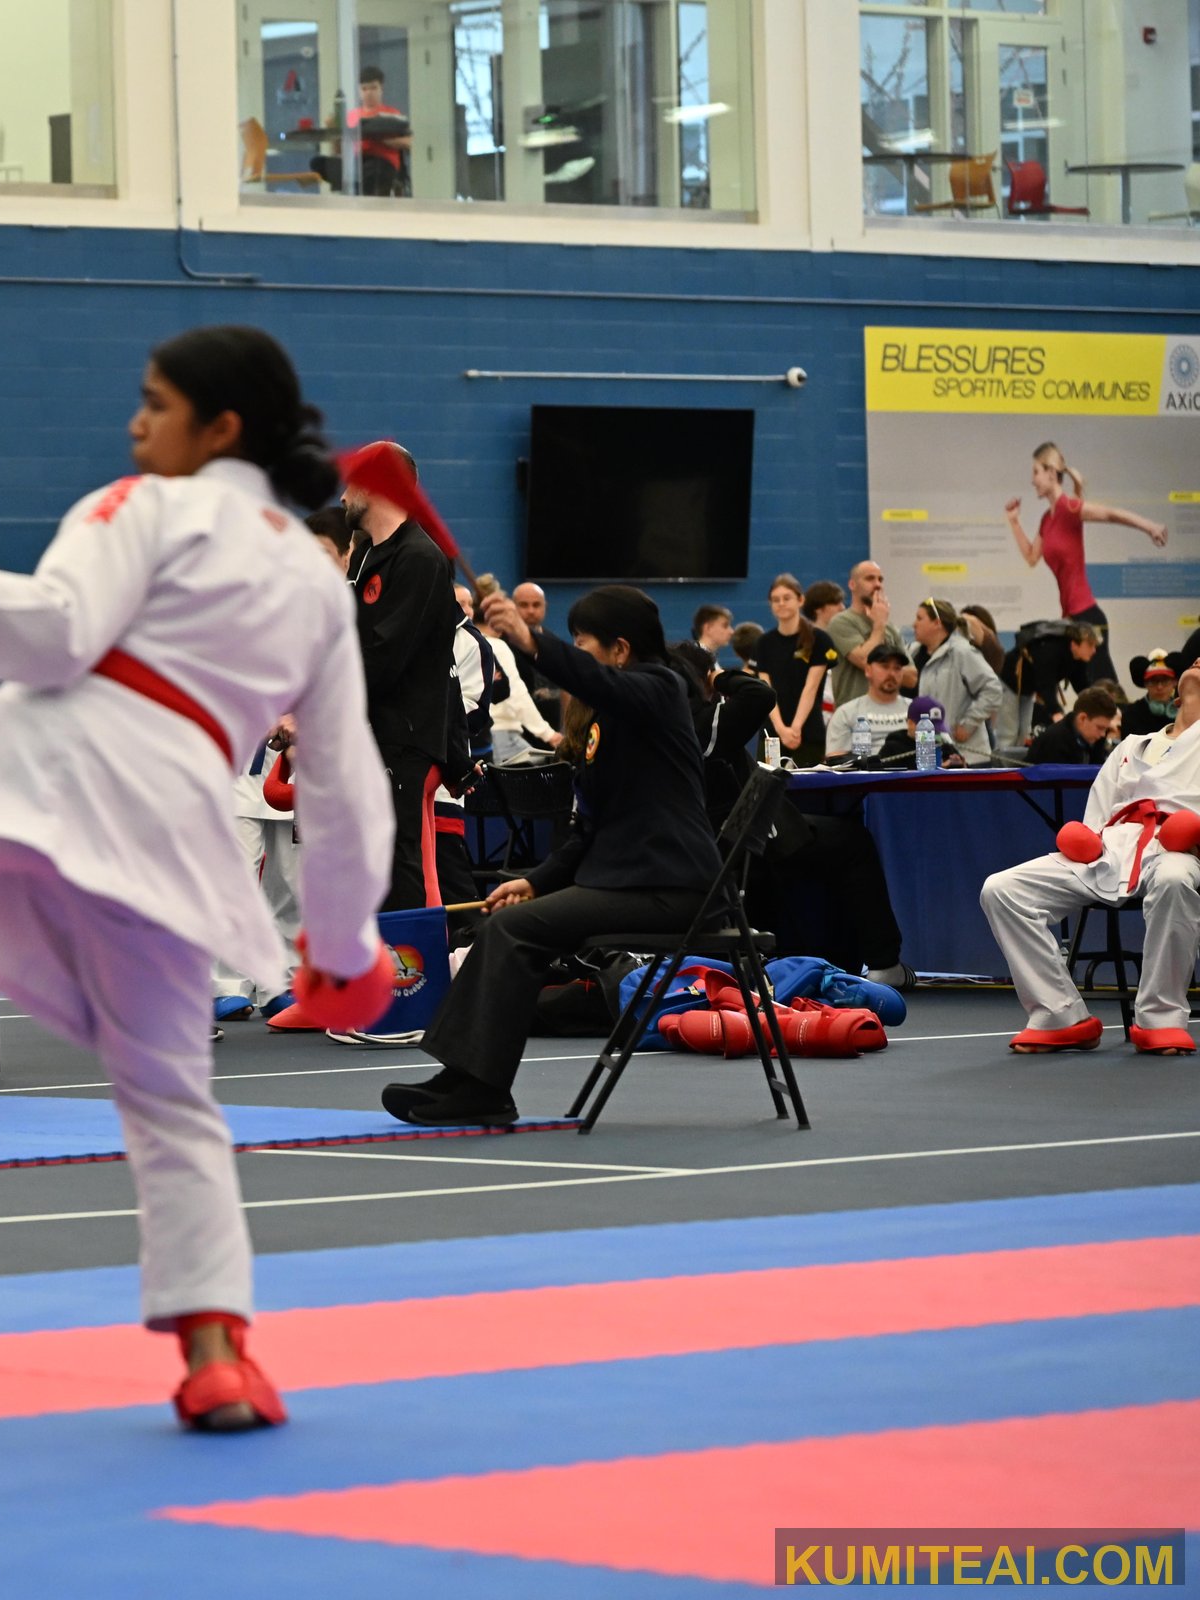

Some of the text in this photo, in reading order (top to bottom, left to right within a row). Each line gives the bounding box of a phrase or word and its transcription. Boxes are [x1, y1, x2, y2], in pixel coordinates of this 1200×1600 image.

[881, 344, 1045, 374] BLESSURES
[933, 377, 1151, 402] SPORTIVES COMMUNES
